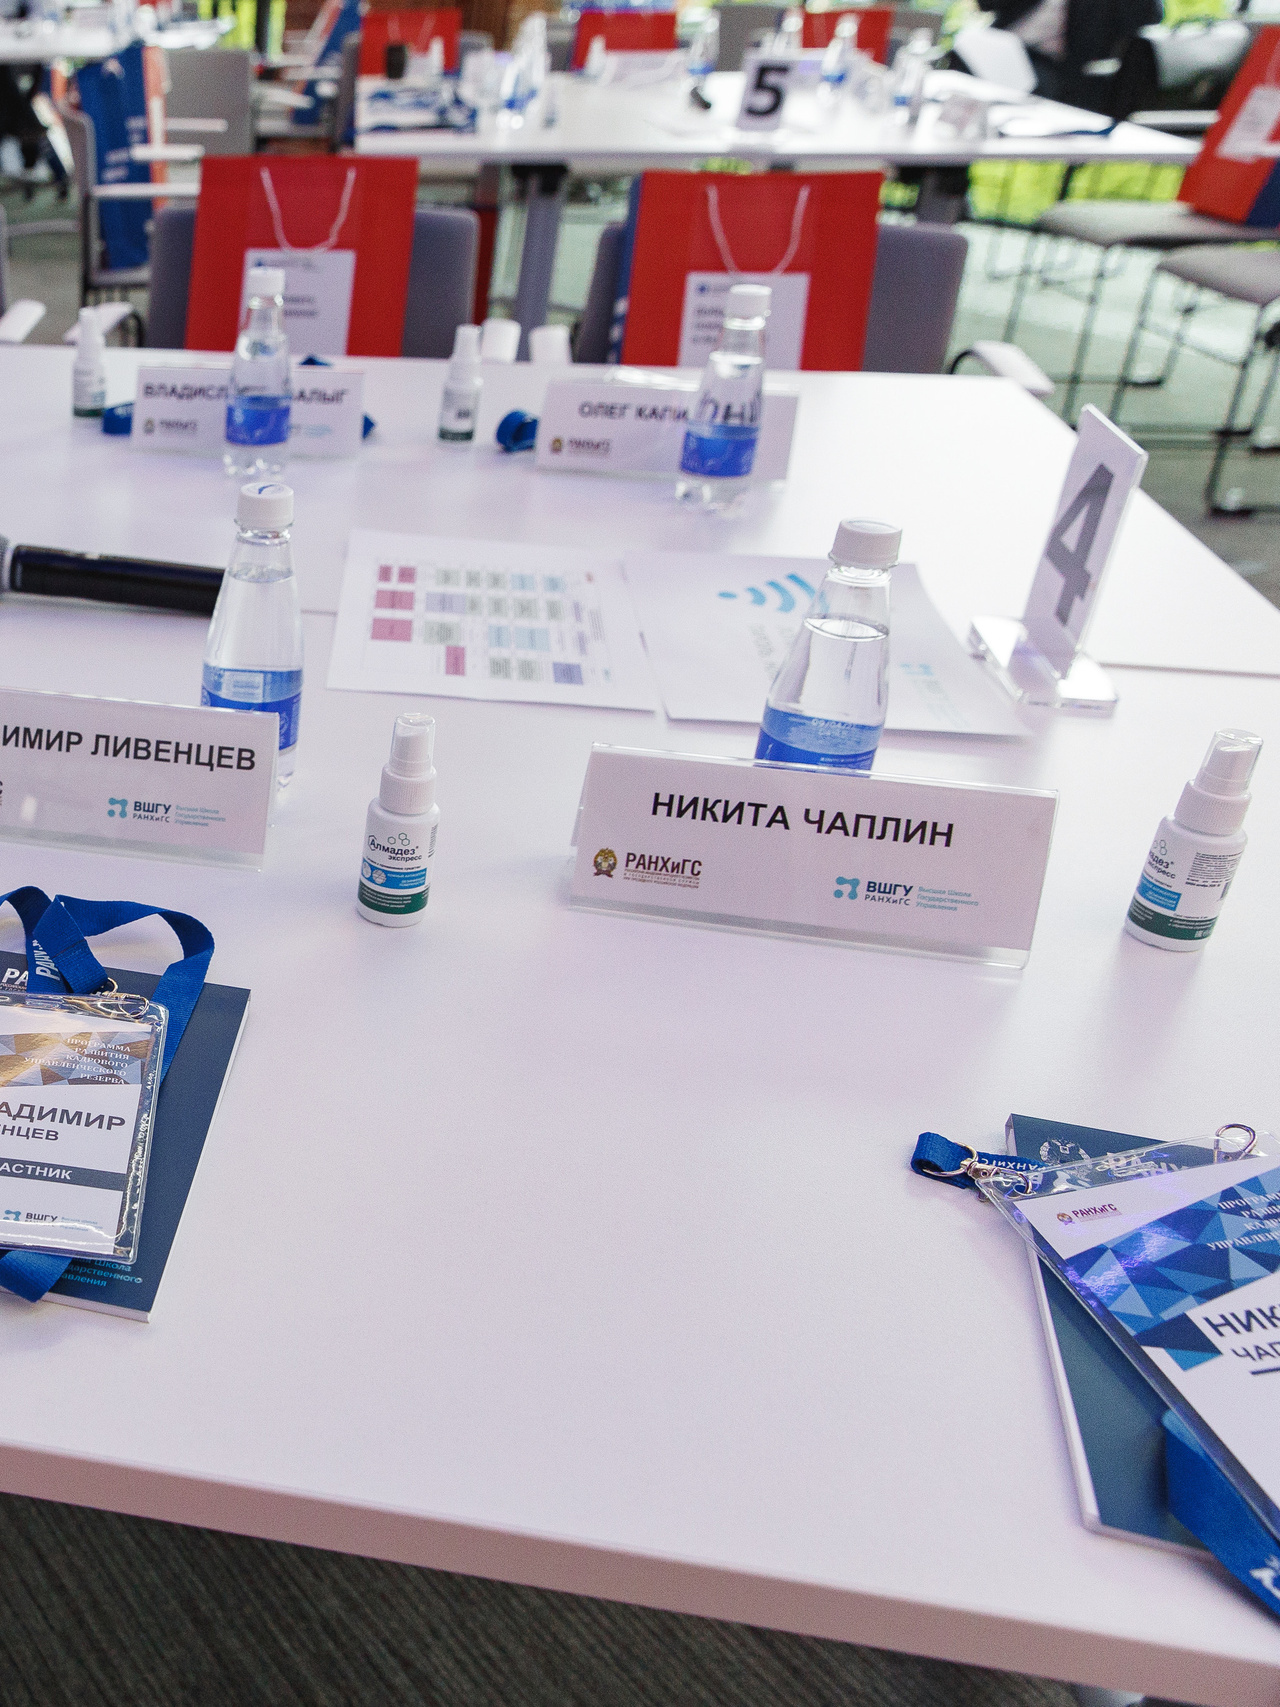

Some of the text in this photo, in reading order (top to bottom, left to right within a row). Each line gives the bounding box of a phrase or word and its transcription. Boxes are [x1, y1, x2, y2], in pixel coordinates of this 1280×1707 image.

[745, 64, 790, 116] 5
[578, 402, 632, 419] ОЛЕГ
[1046, 463, 1115, 627] 4
[91, 733, 256, 771] ЛИВЕНЦЕВ
[133, 801, 172, 814] ВШГУ
[132, 812, 171, 823] РАНХиГС
[652, 792, 955, 848] НИКИТА ЧАПЛИН
[370, 838, 416, 856] Алмадез
[625, 852, 702, 877] РАНХиГС
[866, 880, 914, 897] ВШГУ
[864, 893, 911, 906] РАНХиГС
[67, 1038, 131, 1053] ПРОГРАММА
[24, 1057, 127, 1077] УПРАВЛЕНЧЕСКОГО
[66, 1054, 128, 1069] КАДРОВОГО
[80, 1073, 125, 1085] РЕЗЕРВА
[1218, 1191, 1280, 1210] ПРОГРАМ
[25, 1212, 58, 1223] ВШГУ
[1072, 1203, 1118, 1218] РАНХиГС
[61, 1272, 108, 1287] авления
[68, 1264, 143, 1284] дарственного
[1203, 1304, 1280, 1338] НИК
[1231, 1341, 1280, 1361] ЧАП
